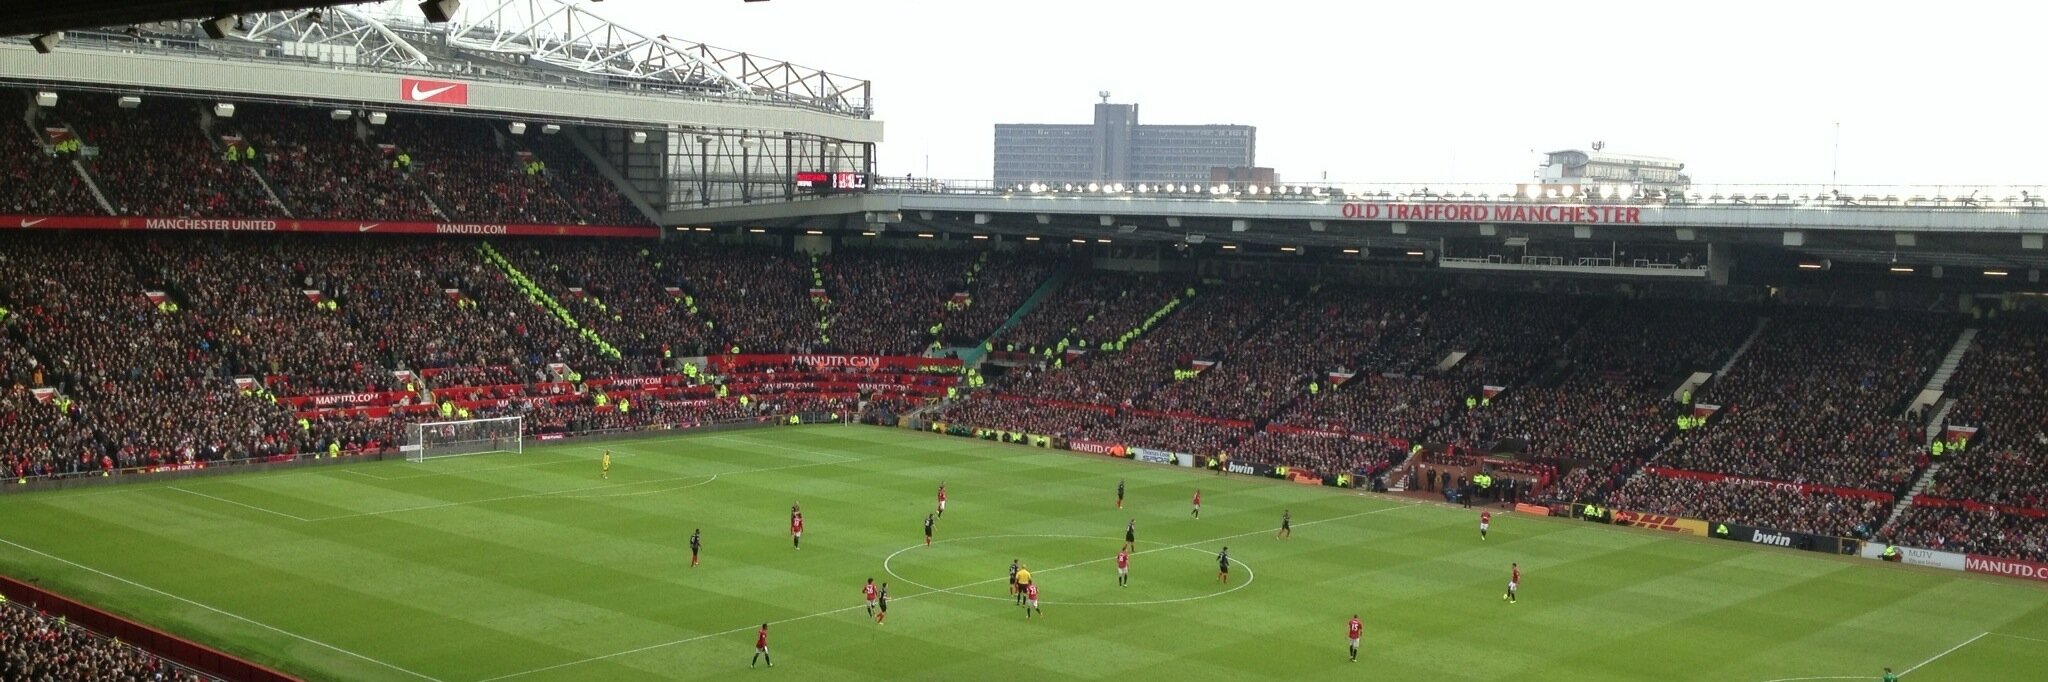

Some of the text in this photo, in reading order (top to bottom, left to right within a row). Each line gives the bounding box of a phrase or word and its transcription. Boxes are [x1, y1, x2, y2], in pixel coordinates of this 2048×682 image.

[1342, 203, 1640, 224] OLD TRAFFORD MANCHESTER
[146, 218, 277, 231] MANCHESTER UNITED
[436, 223, 507, 234] MANUTD.COM
[1228, 461, 1254, 475] bwin
[1752, 530, 1791, 546] bwin
[1908, 549, 1933, 559] MUTV
